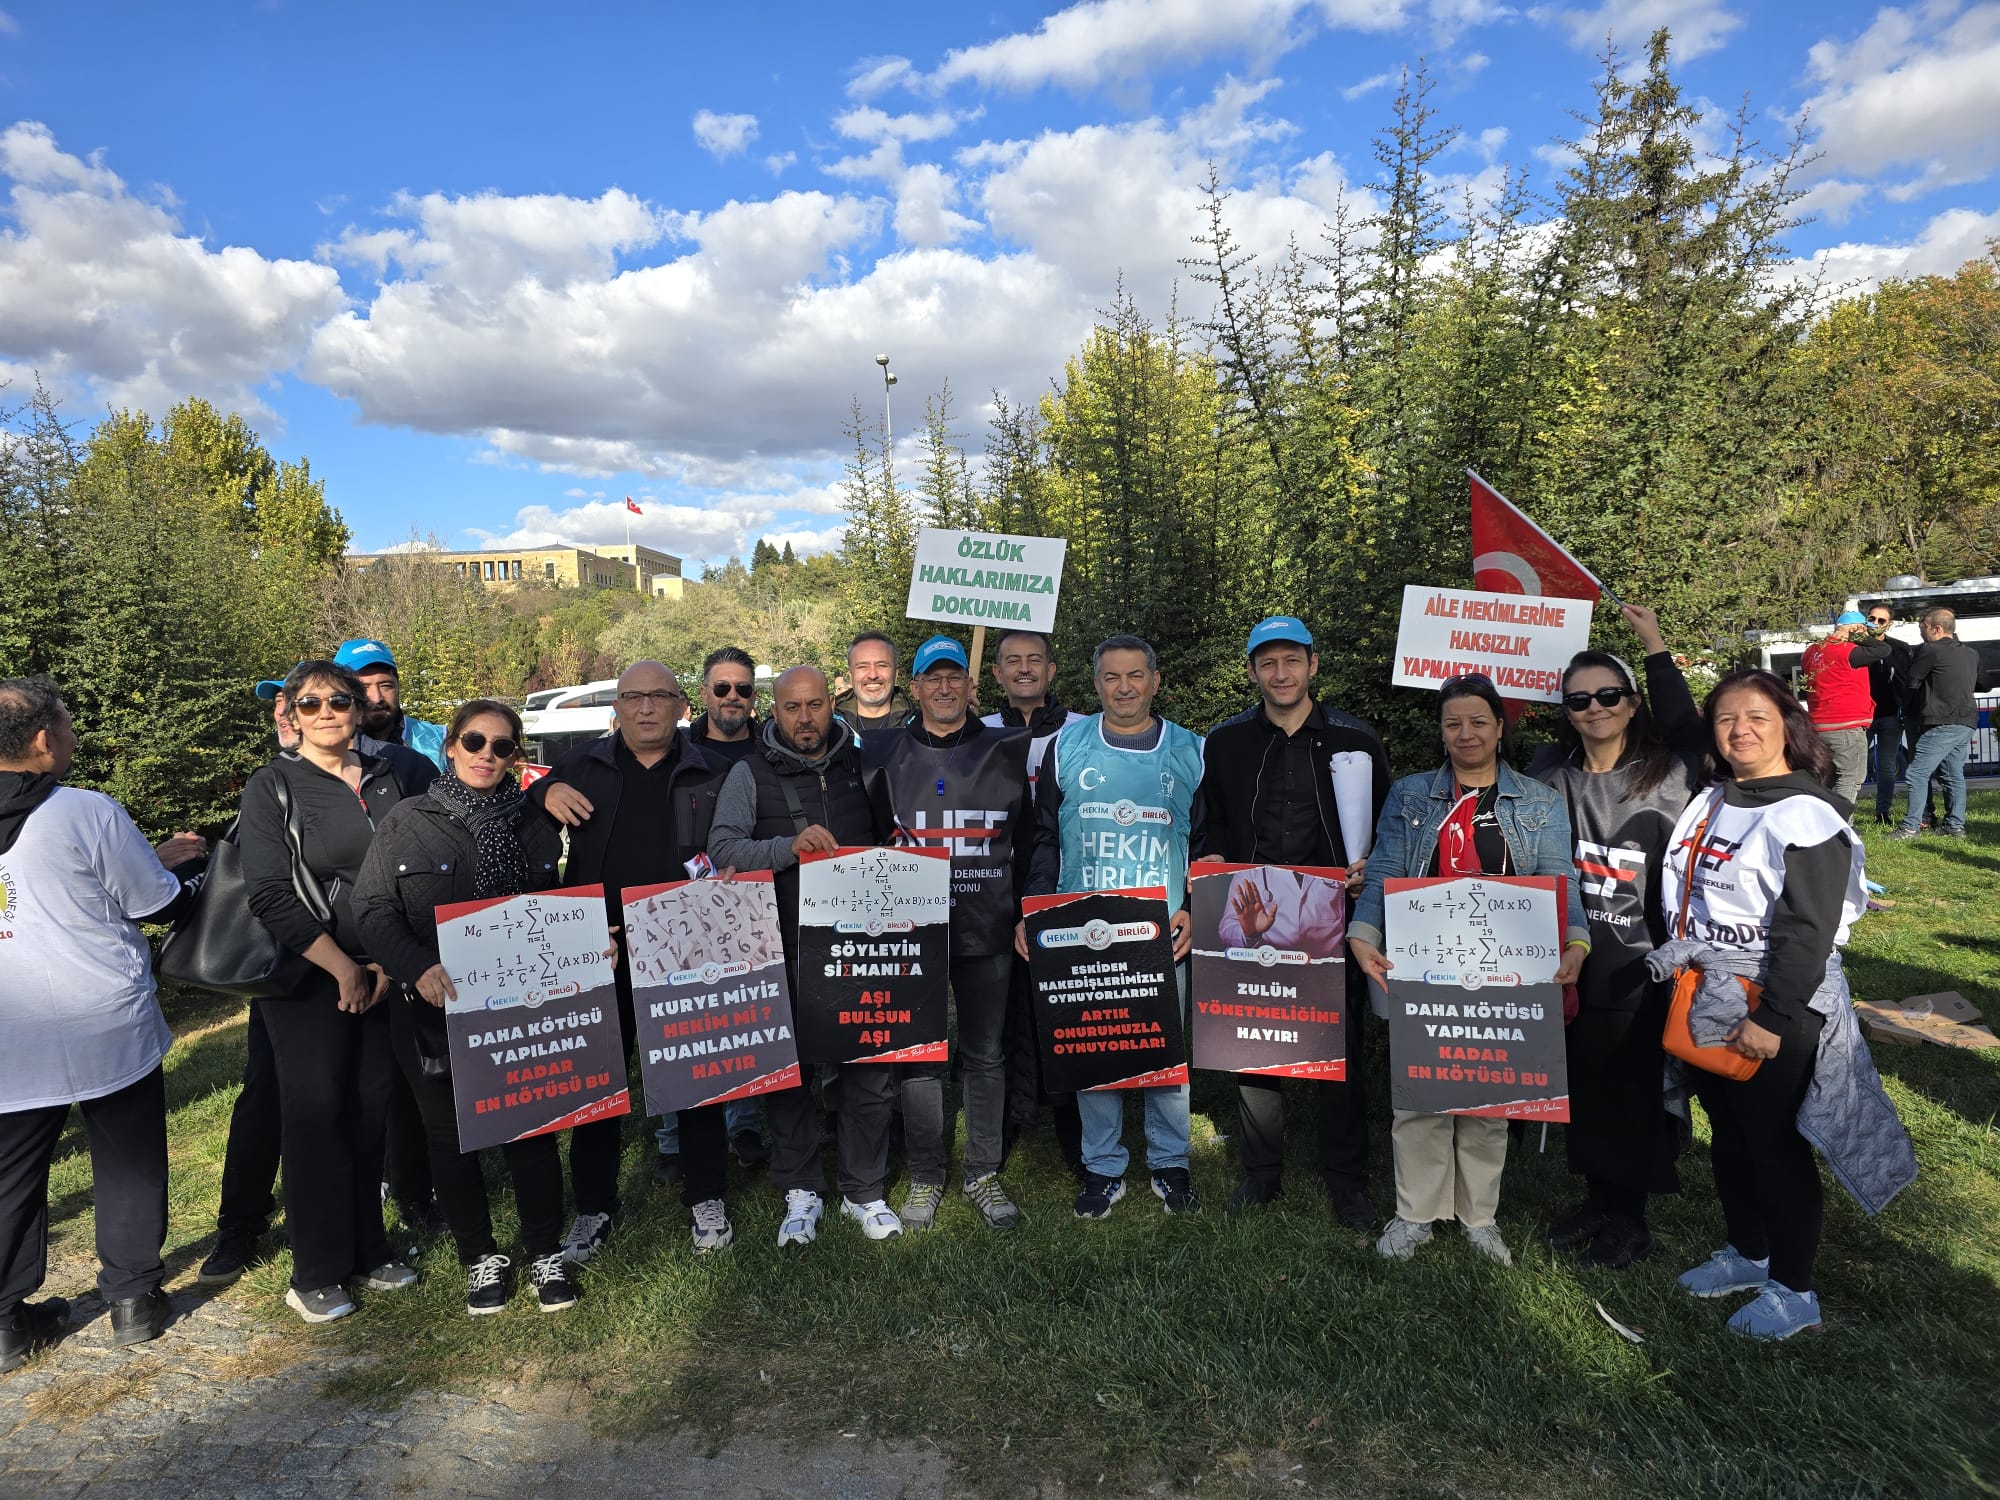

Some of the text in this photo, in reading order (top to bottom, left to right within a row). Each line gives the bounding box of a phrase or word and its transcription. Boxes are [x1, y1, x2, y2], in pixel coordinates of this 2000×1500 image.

[958, 536, 1026, 563] ÖZLÜK
[919, 565, 1054, 594] HAKLARIMIZA
[932, 595, 1031, 622] DOKUNMA
[1424, 593, 1566, 628] AİLE HEKİMLERİNE
[1449, 630, 1532, 656] HAKSIZLIK
[1496, 666, 1561, 695] VAZGEÇİ
[1143, 810, 1168, 820] BİRLİĞ
[1082, 830, 1169, 864] HEKİM
[1082, 861, 1168, 889] BİRLİĞİ
[1587, 909, 1631, 927] NEKLERİ
[1047, 926, 1150, 943] HEKİM BİRLİĞİ
[831, 939, 921, 957] SÖYLEYİN
[674, 965, 746, 981] HEKİM BİRLİĞİ
[1071, 961, 1128, 975] ESKİDEN
[1039, 972, 1164, 992] HAKEDİŞLERİMİZLE
[1237, 982, 1297, 999] ZULÜM
[493, 985, 573, 1006] HEKİM BİRLİĞİ
[650, 980, 780, 1018] KURYE MİYİZ
[860, 991, 891, 1008] AŞI
[1049, 987, 1158, 1004] OYNUYORLARDI!
[839, 1010, 911, 1024] BULSUN
[1081, 1008, 1129, 1022] ARTIK
[1197, 1000, 1340, 1024] YÖNETMELİĞİNE
[1405, 1002, 1544, 1020] DAHA KÖTÜSÜ
[468, 1008, 603, 1048] DAHA KÖTÜSÜ
[664, 1012, 729, 1039] HEKİM
[734, 1008, 757, 1026] Mİ
[1053, 1022, 1161, 1039] ONURUMUZLA
[1425, 1025, 1525, 1042] YAPILANA
[649, 1025, 791, 1064] PUANLAMAYA
[859, 1030, 890, 1047] AŞI
[1237, 1027, 1298, 1043] HAYIR!
[491, 1036, 587, 1065] YAPILANA
[1053, 1037, 1166, 1055] OYNUYORLAR!
[1439, 1046, 1508, 1062] KADAR
[507, 1059, 574, 1085] KADAR
[692, 1055, 756, 1080] HAYIR
[1408, 1065, 1548, 1087] EN KÖTÜSÜ BU
[475, 1072, 610, 1115] EN KÖTÜSÜ BU
